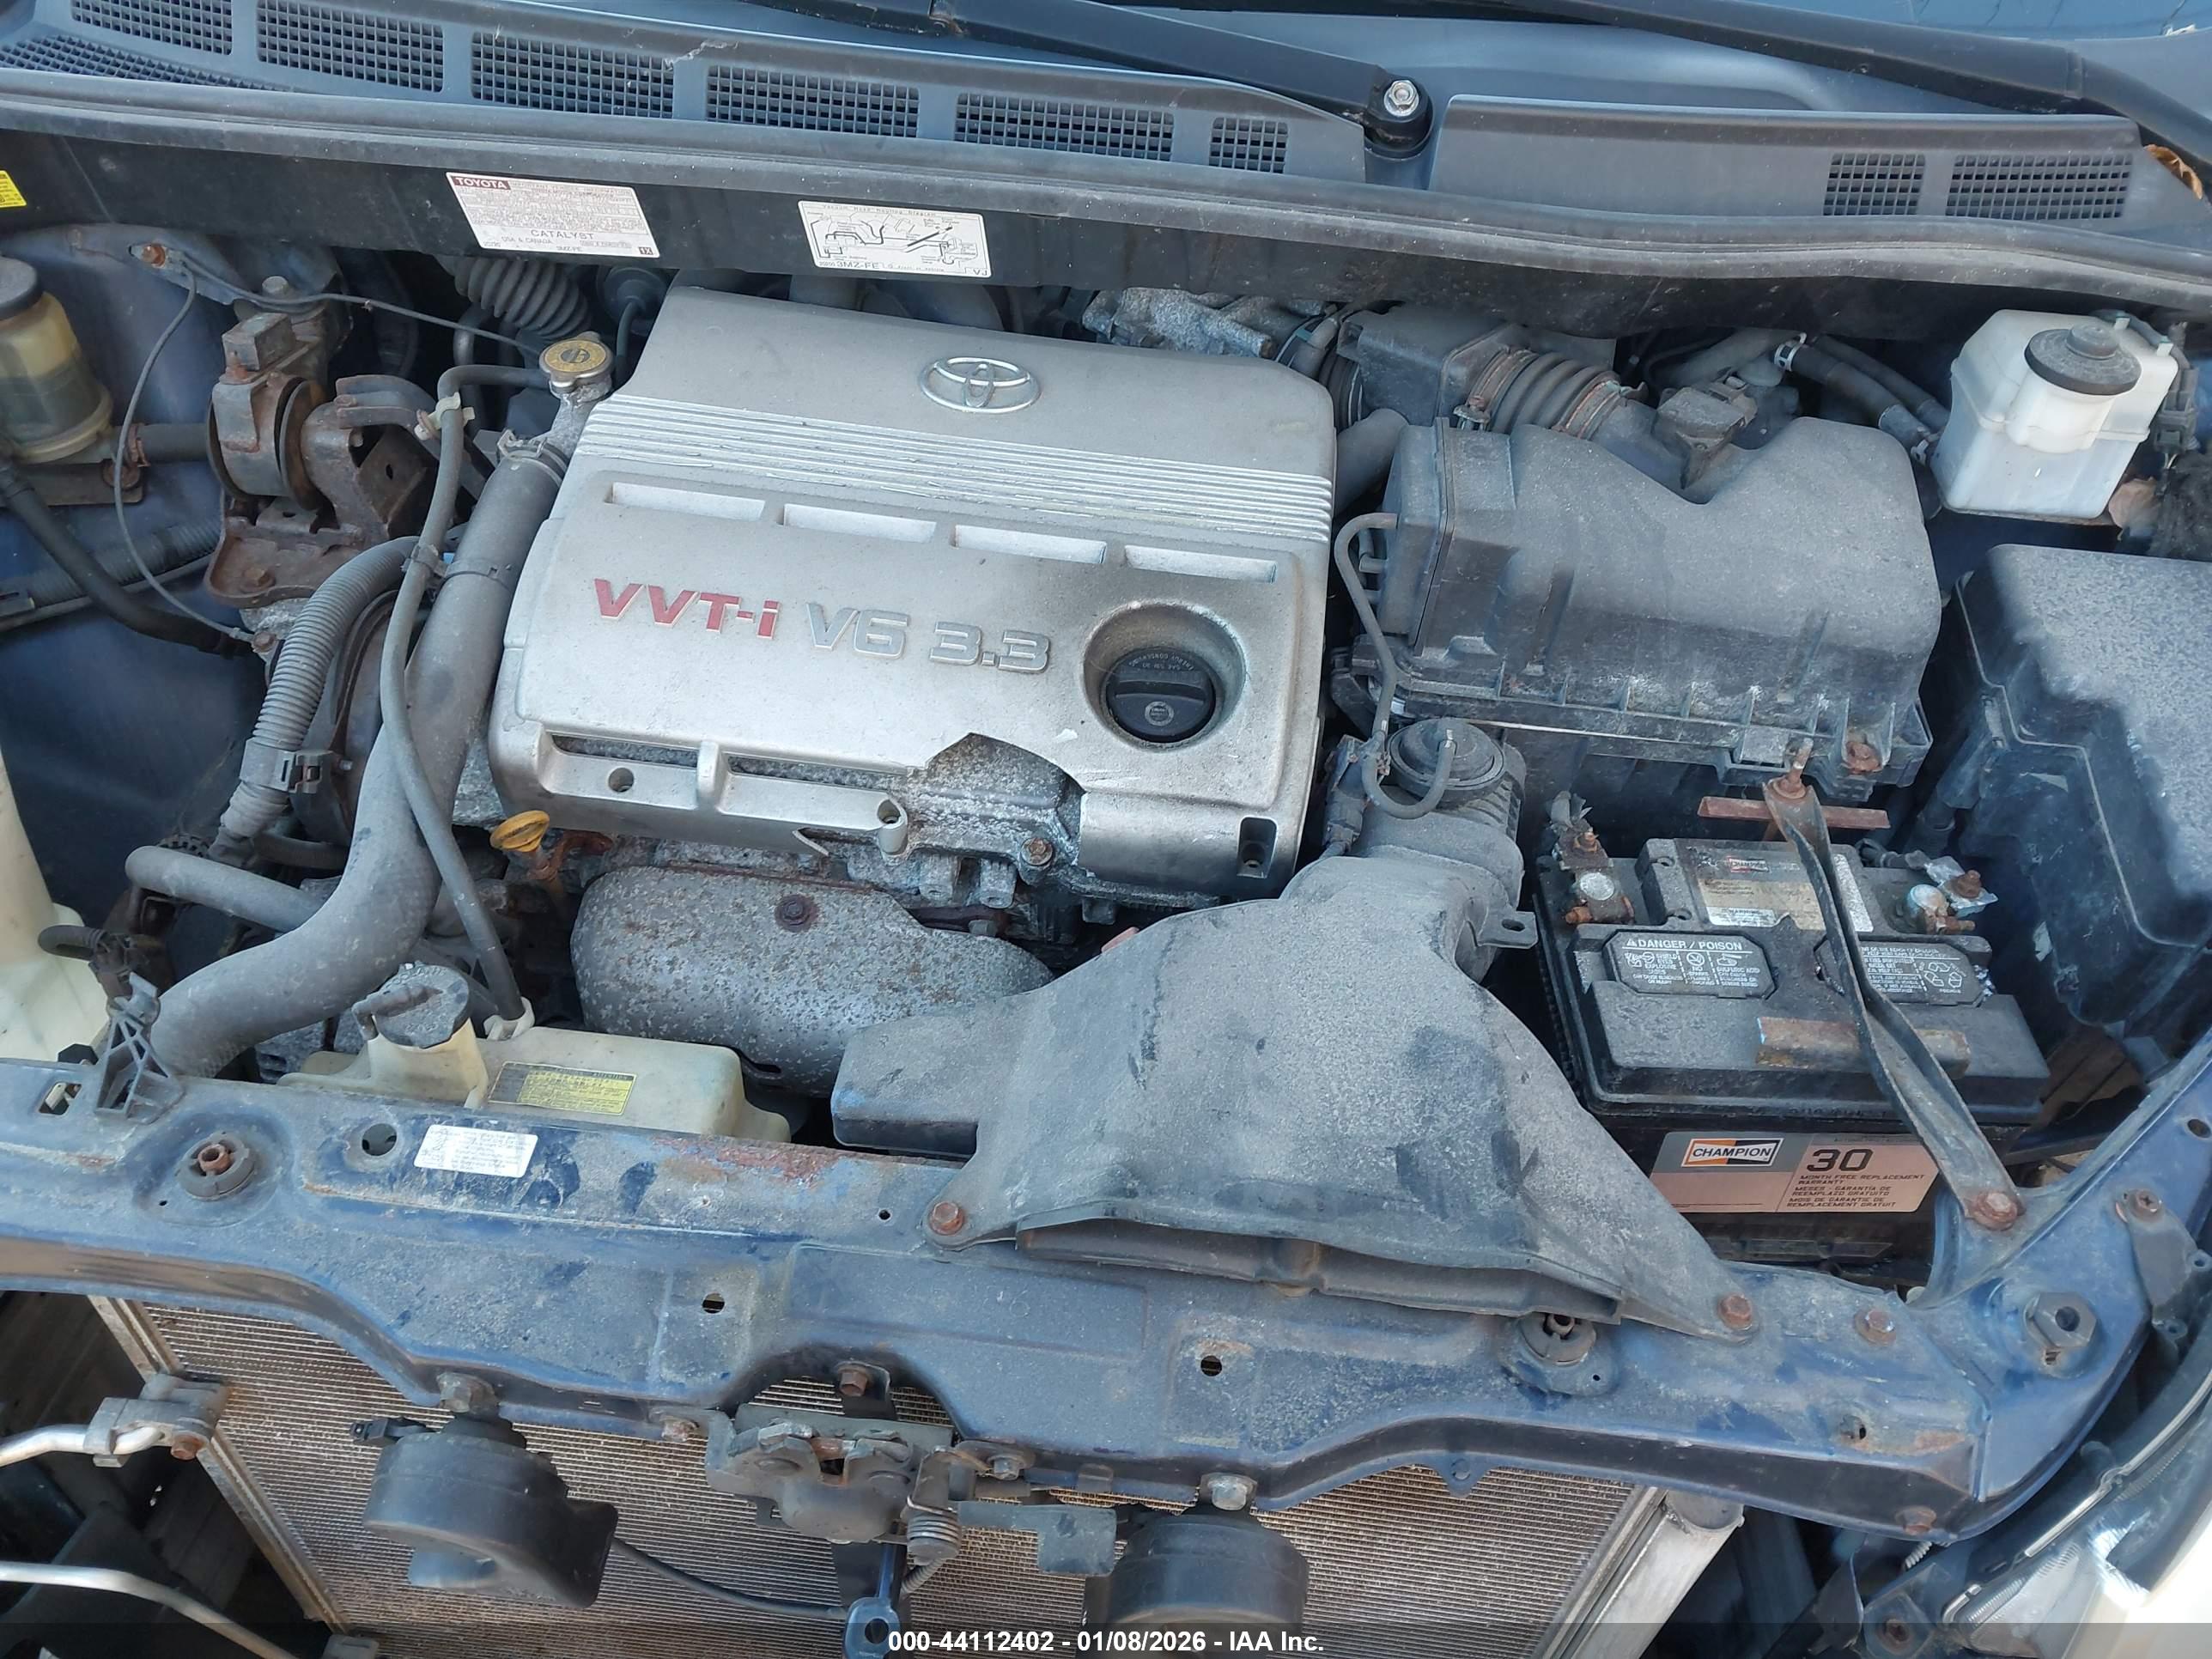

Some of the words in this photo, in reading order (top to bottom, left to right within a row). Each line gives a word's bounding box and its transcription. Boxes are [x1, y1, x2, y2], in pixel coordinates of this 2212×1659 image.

[454, 177, 508, 190] TOYOTA
[531, 229, 594, 240] CATALYST
[836, 261, 880, 270] 3MZ-FE
[594, 579, 781, 639] VVT-i
[805, 601, 911, 659] V6
[928, 621, 1051, 674] 3.3
[1638, 939, 1686, 949] DANGER
[1698, 941, 1742, 950] POISON
[1692, 1146, 1771, 1158] CHAMPION
[1807, 1149, 1875, 1171] 30
